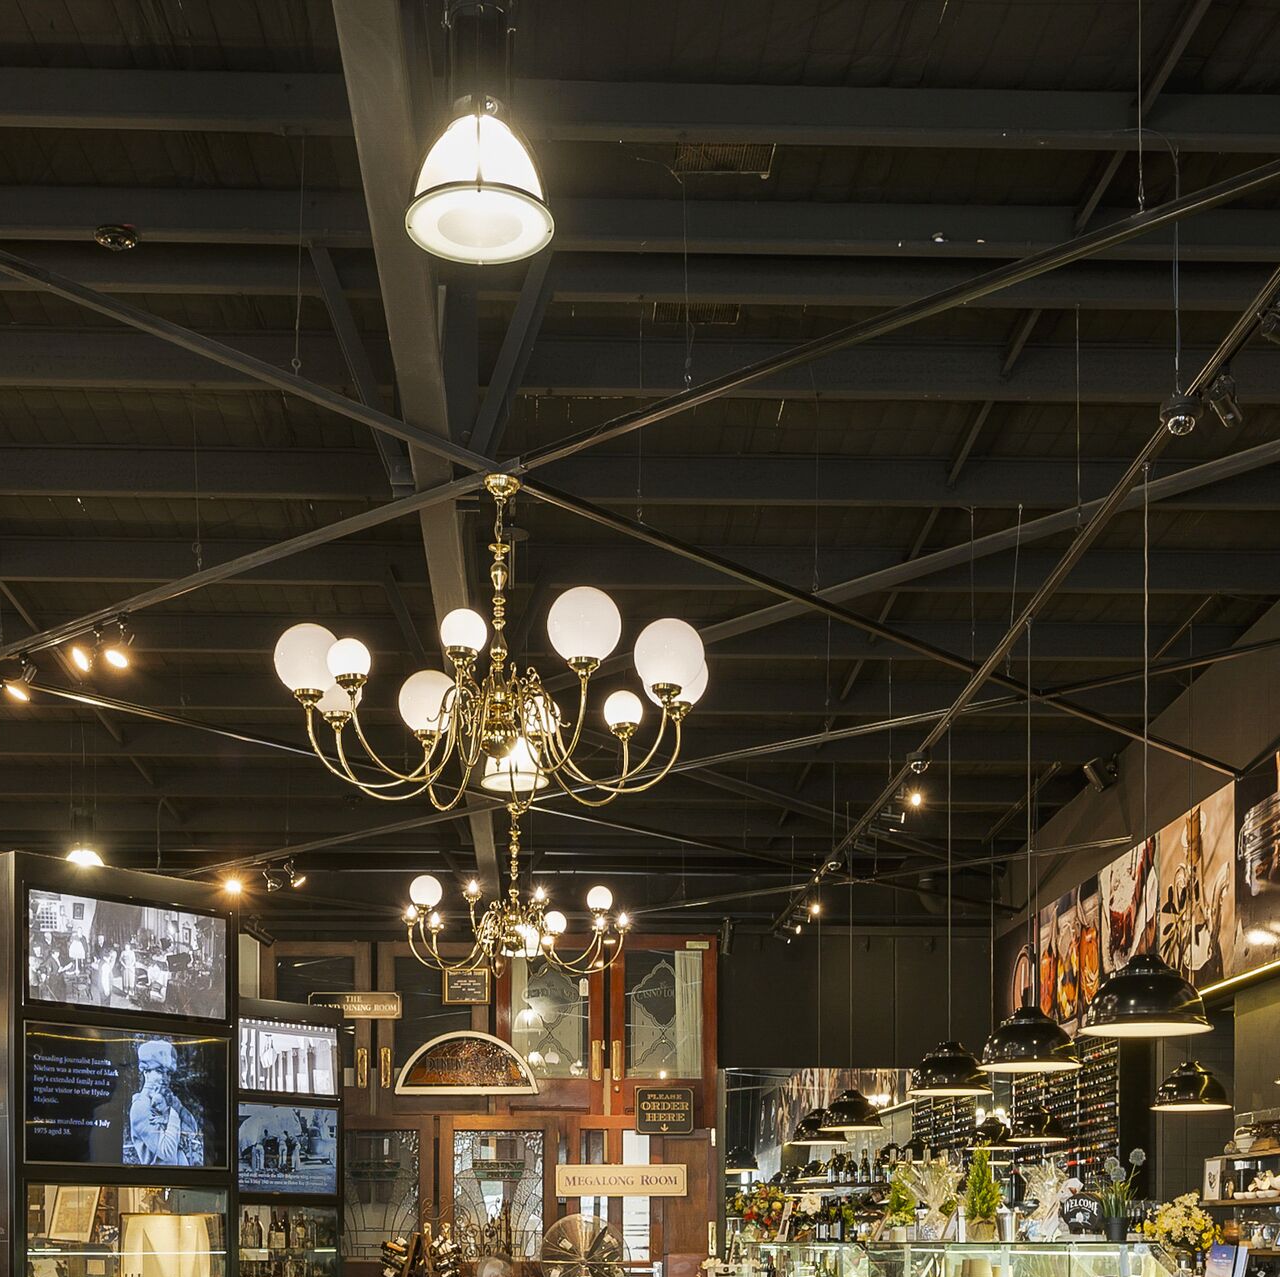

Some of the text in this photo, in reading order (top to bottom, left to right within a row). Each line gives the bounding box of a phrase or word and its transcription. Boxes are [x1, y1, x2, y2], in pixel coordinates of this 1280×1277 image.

[345, 995, 362, 1003] THE
[343, 1003, 371, 1011] DINING
[374, 1003, 397, 1011] ROOM
[641, 1102, 689, 1110] ORDER
[645, 1113, 685, 1122] HERE
[99, 1120, 110, 1128] July
[564, 1174, 678, 1186] MEGALONG ROOM
[1064, 1198, 1099, 1216] WELCOME
